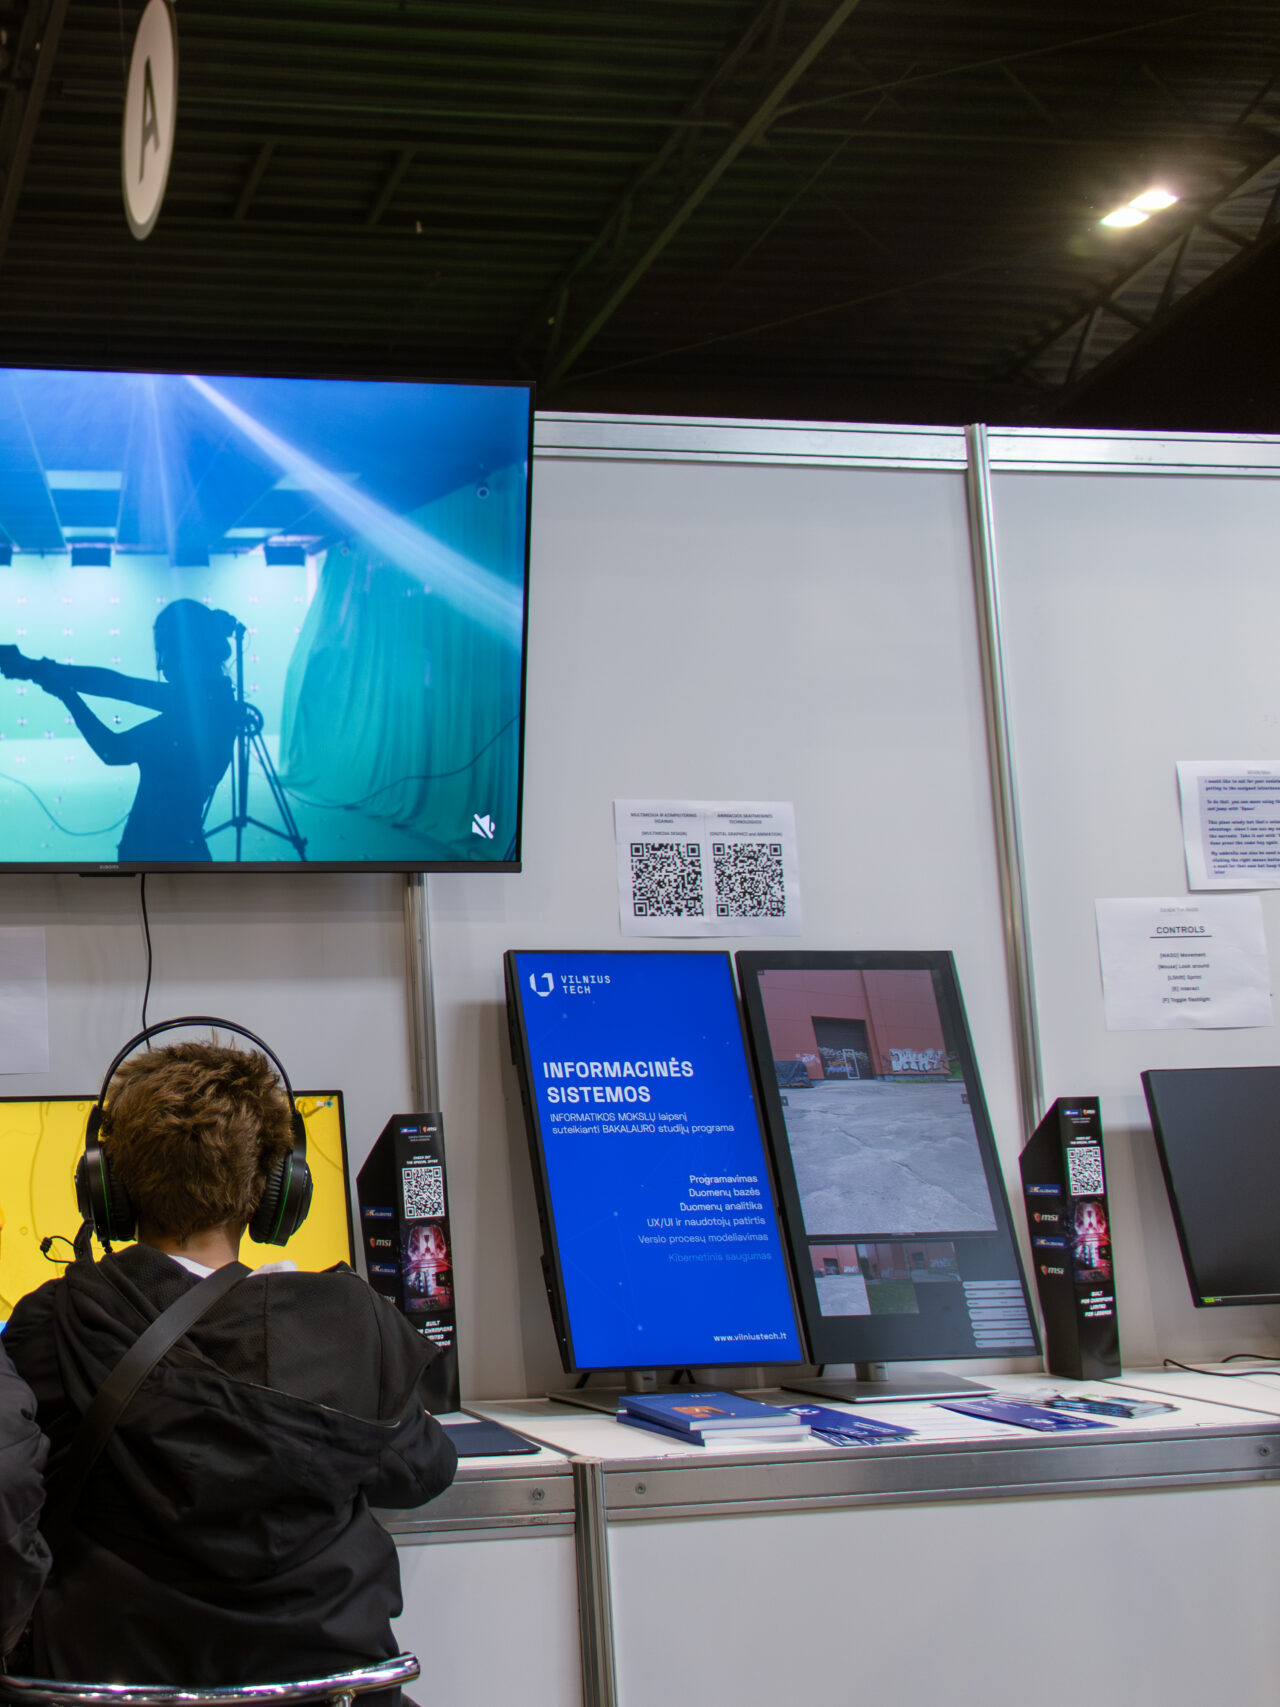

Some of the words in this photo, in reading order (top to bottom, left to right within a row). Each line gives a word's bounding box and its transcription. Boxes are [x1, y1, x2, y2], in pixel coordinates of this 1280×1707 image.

[138, 54, 160, 185] A
[1156, 925, 1206, 934] CONTROLS
[561, 975, 611, 984] VILNIUS
[563, 985, 591, 994] TECH
[543, 1057, 694, 1078] INFORMACINĖS
[547, 1086, 651, 1103] SISTEMOS
[550, 1112, 616, 1122] INFORMATIKOS
[618, 1112, 656, 1123] MOKSLŲ
[658, 1112, 687, 1123] laipsnį
[552, 1124, 600, 1134] suteikianti
[602, 1124, 656, 1133] BAKALAURO
[658, 1123, 689, 1135] studijų
[691, 1124, 734, 1135] programa
[689, 1174, 758, 1186] Programavimas
[688, 1188, 731, 1198] Duomenų
[733, 1187, 760, 1197] bazės
[680, 1202, 722, 1212] Duomenų
[724, 1201, 763, 1211] analitika
[647, 1217, 674, 1228] UX/UI
[675, 1217, 682, 1227] ir
[684, 1216, 731, 1228] naudotojų
[733, 1216, 766, 1227] patirtis
[638, 1235, 667, 1245] Verslo
[708, 1232, 768, 1243] modeliavimas
[1048, 1267, 1064, 1275] msi
[713, 1331, 787, 1342] www.vilniustech.lt
